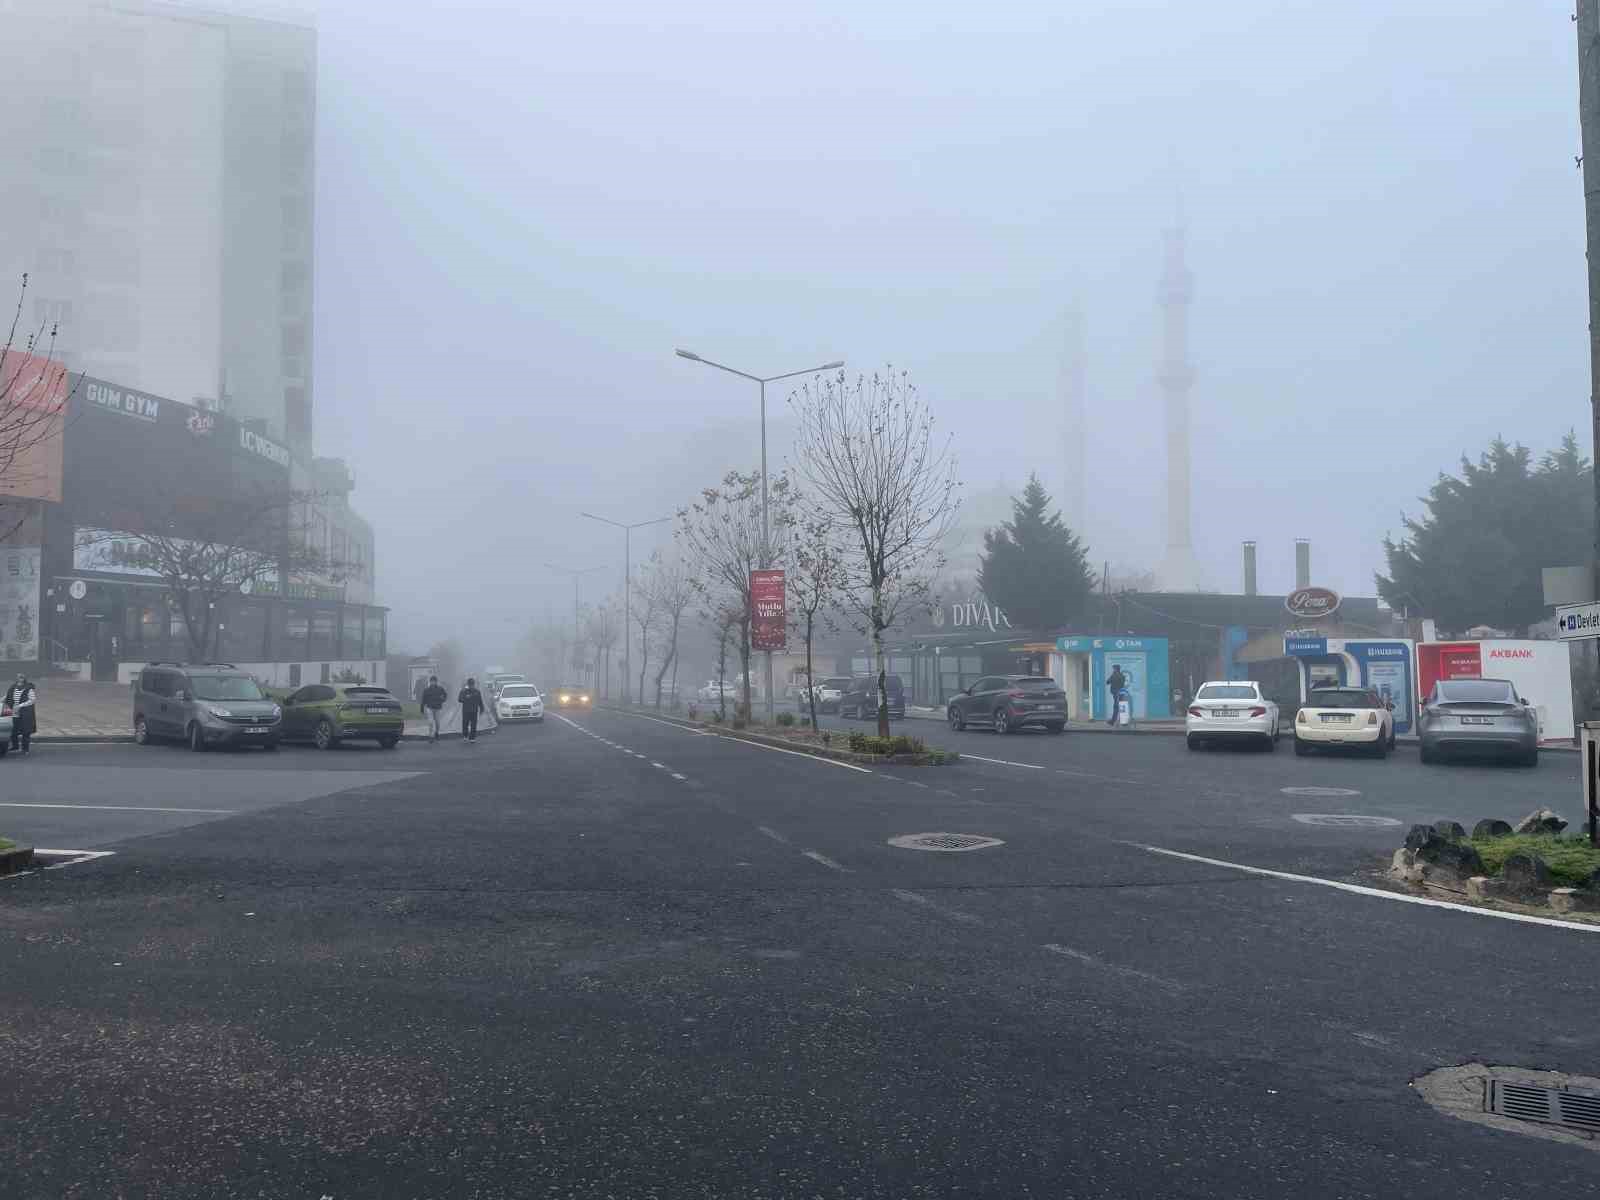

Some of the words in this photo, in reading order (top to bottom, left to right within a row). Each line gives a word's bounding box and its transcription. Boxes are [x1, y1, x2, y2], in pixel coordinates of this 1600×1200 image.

[86, 383, 120, 408] GUM
[125, 394, 160, 417] GYM
[1489, 649, 1535, 659] AKBANK
